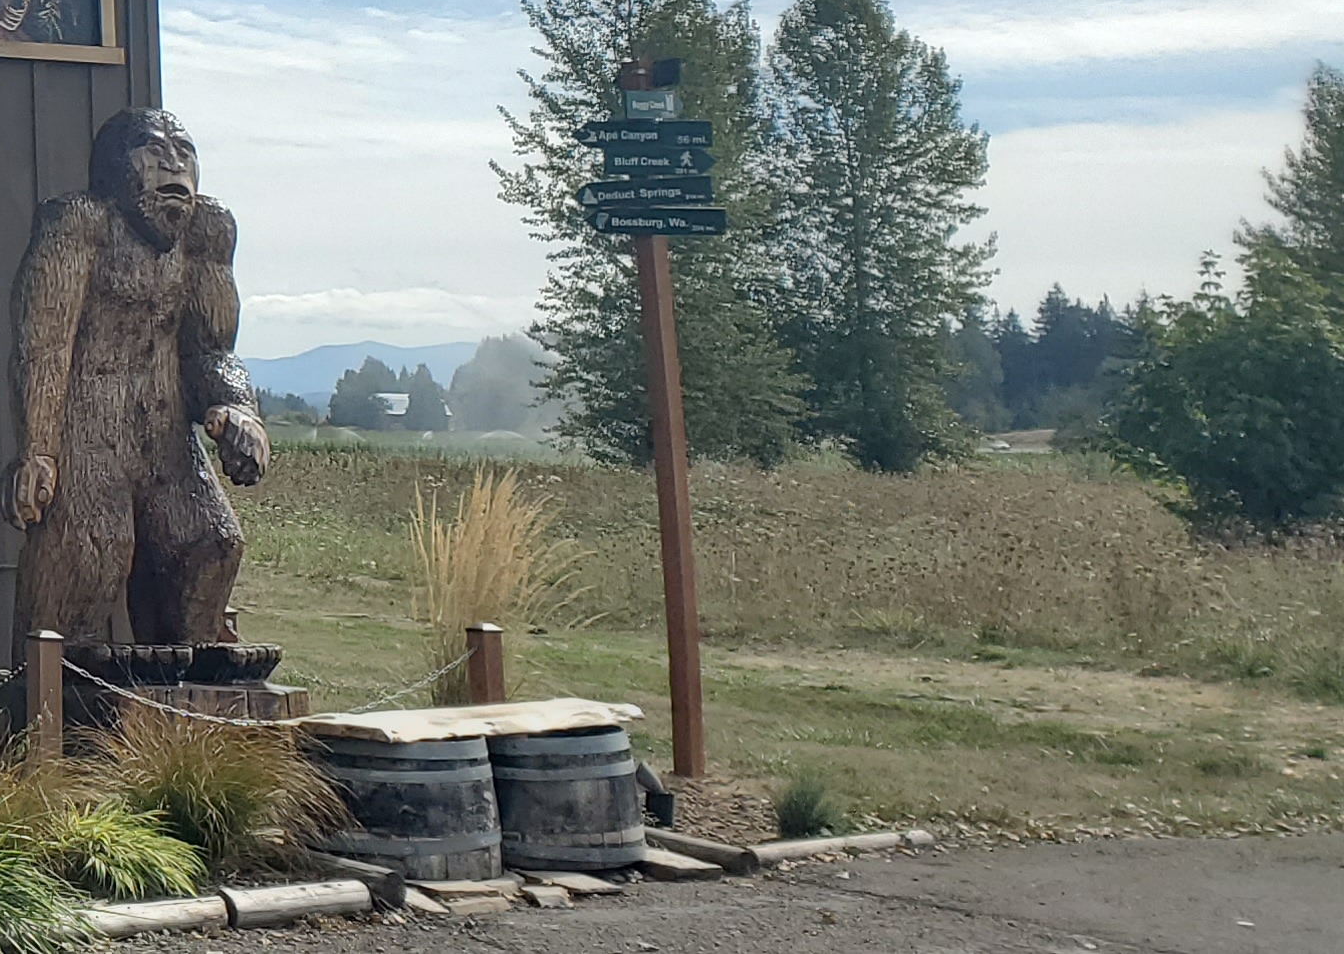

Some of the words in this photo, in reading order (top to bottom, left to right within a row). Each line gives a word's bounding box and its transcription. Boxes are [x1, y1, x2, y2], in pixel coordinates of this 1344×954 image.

[598, 131, 617, 141] Ape
[620, 130, 658, 142] Canyon
[614, 157, 638, 166] Bluff
[640, 157, 670, 166] Creek
[639, 188, 682, 200] Springs
